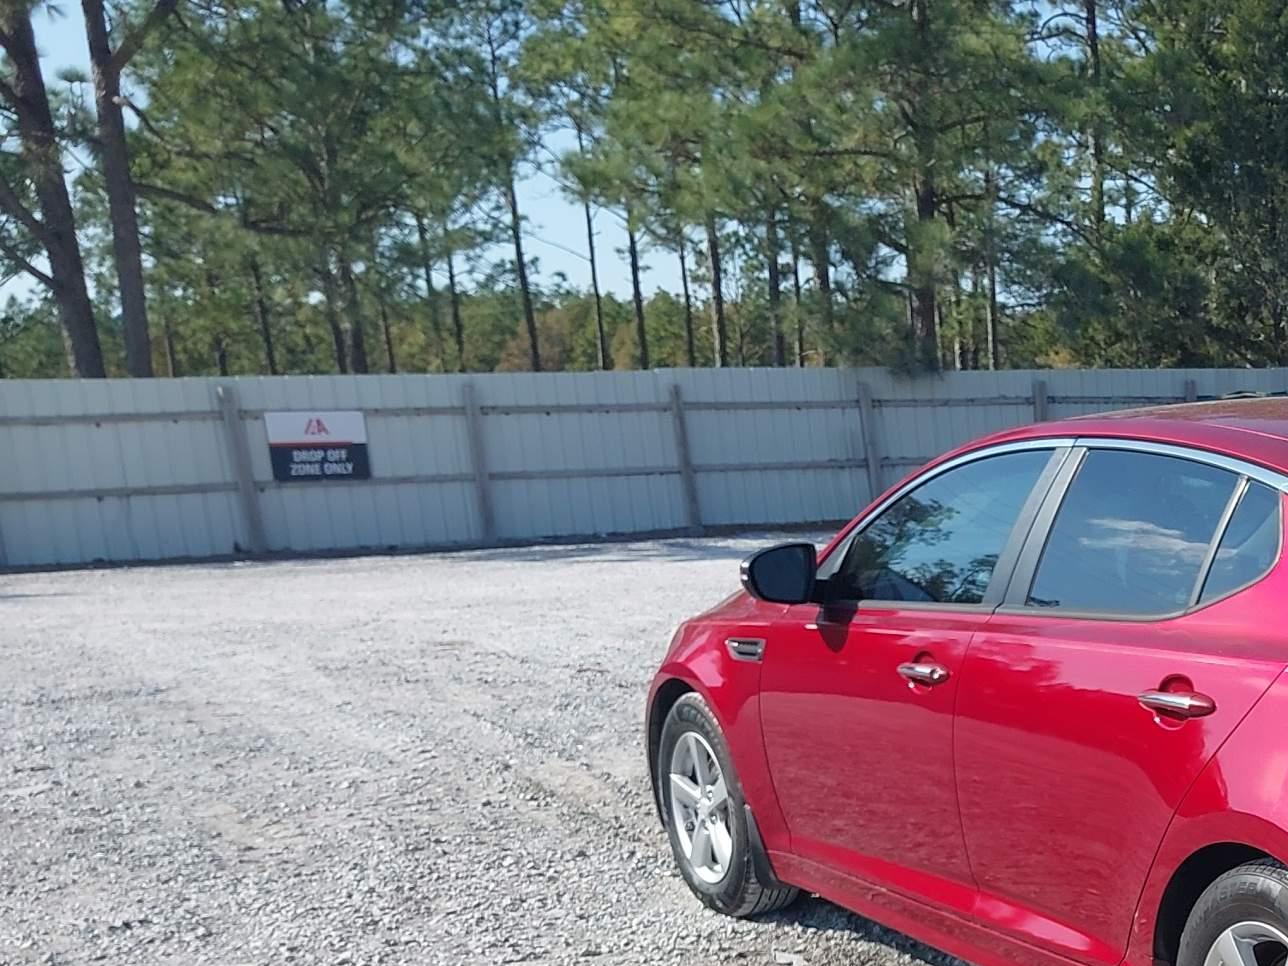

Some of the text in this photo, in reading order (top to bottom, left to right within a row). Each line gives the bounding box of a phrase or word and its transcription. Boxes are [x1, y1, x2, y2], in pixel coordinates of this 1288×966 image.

[292, 449, 348, 462] DROP OFF
[290, 462, 353, 476] ZONE ONLY
